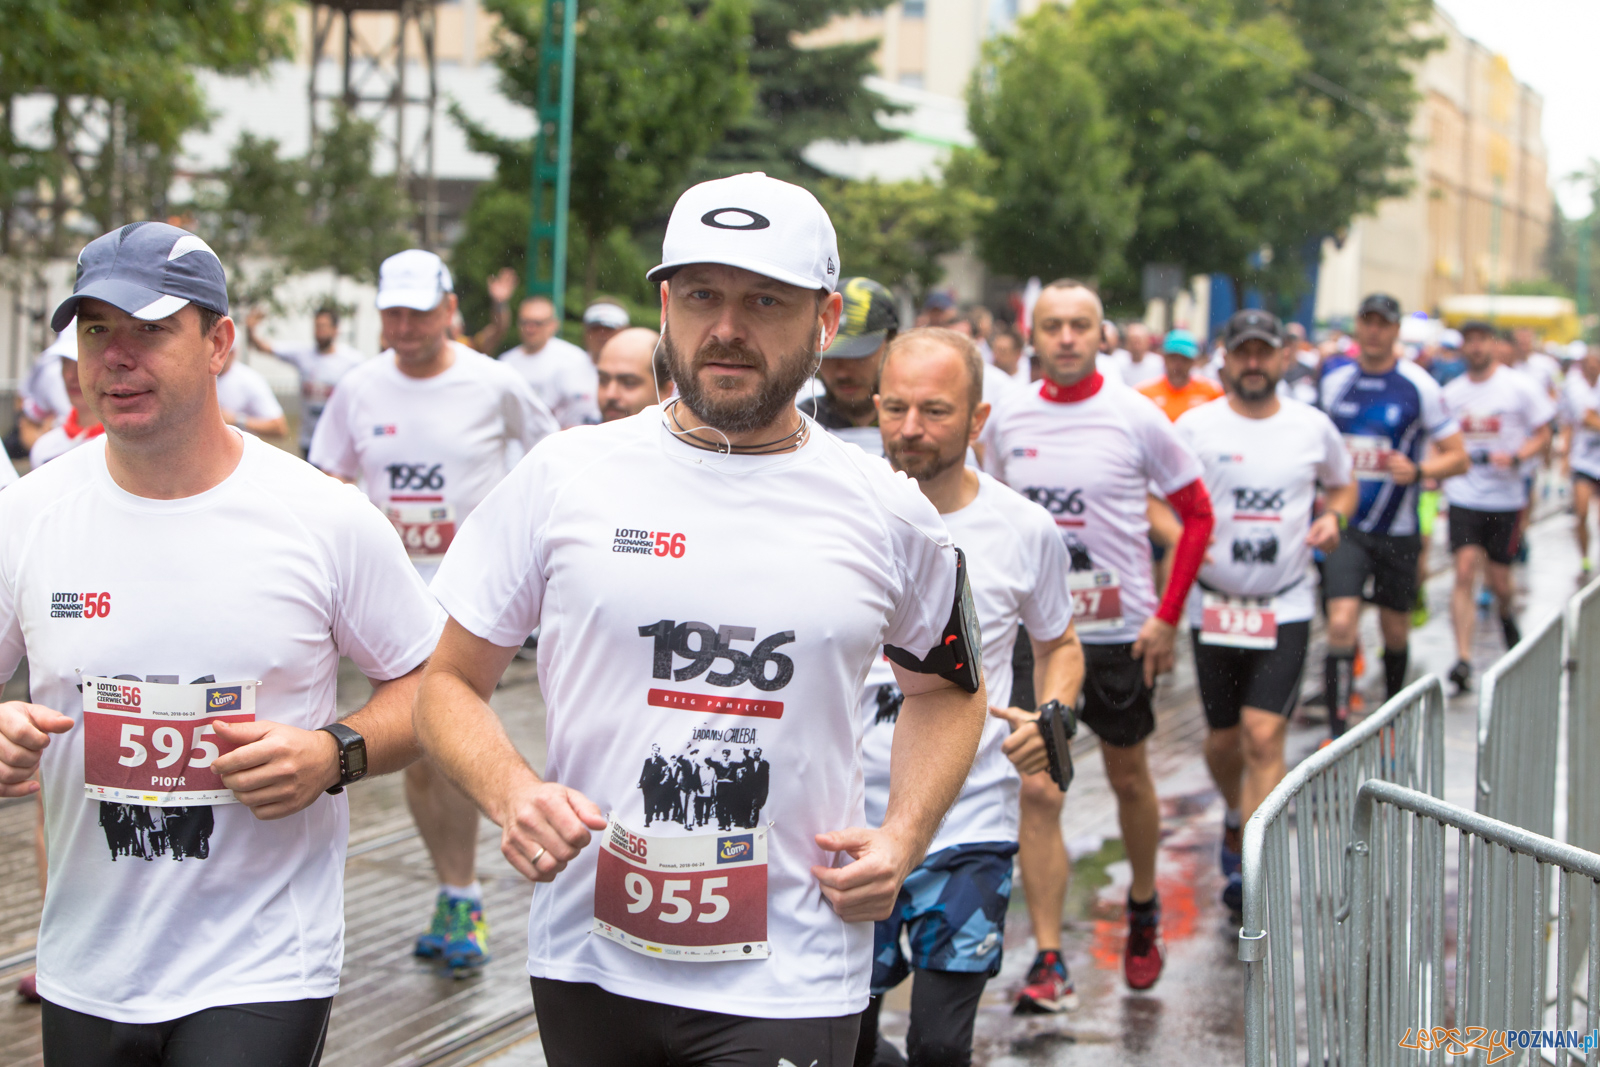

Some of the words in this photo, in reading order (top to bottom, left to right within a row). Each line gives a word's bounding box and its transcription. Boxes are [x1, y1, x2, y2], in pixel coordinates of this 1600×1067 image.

[385, 464, 443, 490] 1956
[1233, 487, 1285, 511] 1956
[398, 524, 442, 549] 66
[613, 538, 653, 547] POZNAŃSKI
[615, 528, 648, 539] LOTTO
[649, 531, 686, 558] '56
[612, 545, 653, 555] CZERWIEC
[50, 610, 83, 618] CZERWIEC
[52, 592, 78, 602] LOTTO
[79, 592, 111, 619] '56
[1217, 609, 1263, 634] 130
[638, 619, 796, 692] 1956
[97, 682, 118, 692] LOTTO
[118, 685, 142, 706] '56
[97, 695, 122, 704] CZERWIEC
[214, 695, 233, 705] LOTTO
[664, 695, 696, 705] BIEG
[707, 700, 766, 712] PAMIĘCI
[118, 724, 220, 769] 595
[692, 726, 724, 742] ŻĄDAMY
[723, 727, 757, 745] CHLEBA
[151, 776, 186, 787] PIOTR
[613, 822, 626, 837] LOTTO
[626, 831, 648, 857] '56
[726, 844, 745, 856] LOTTO
[624, 872, 730, 924] 955
